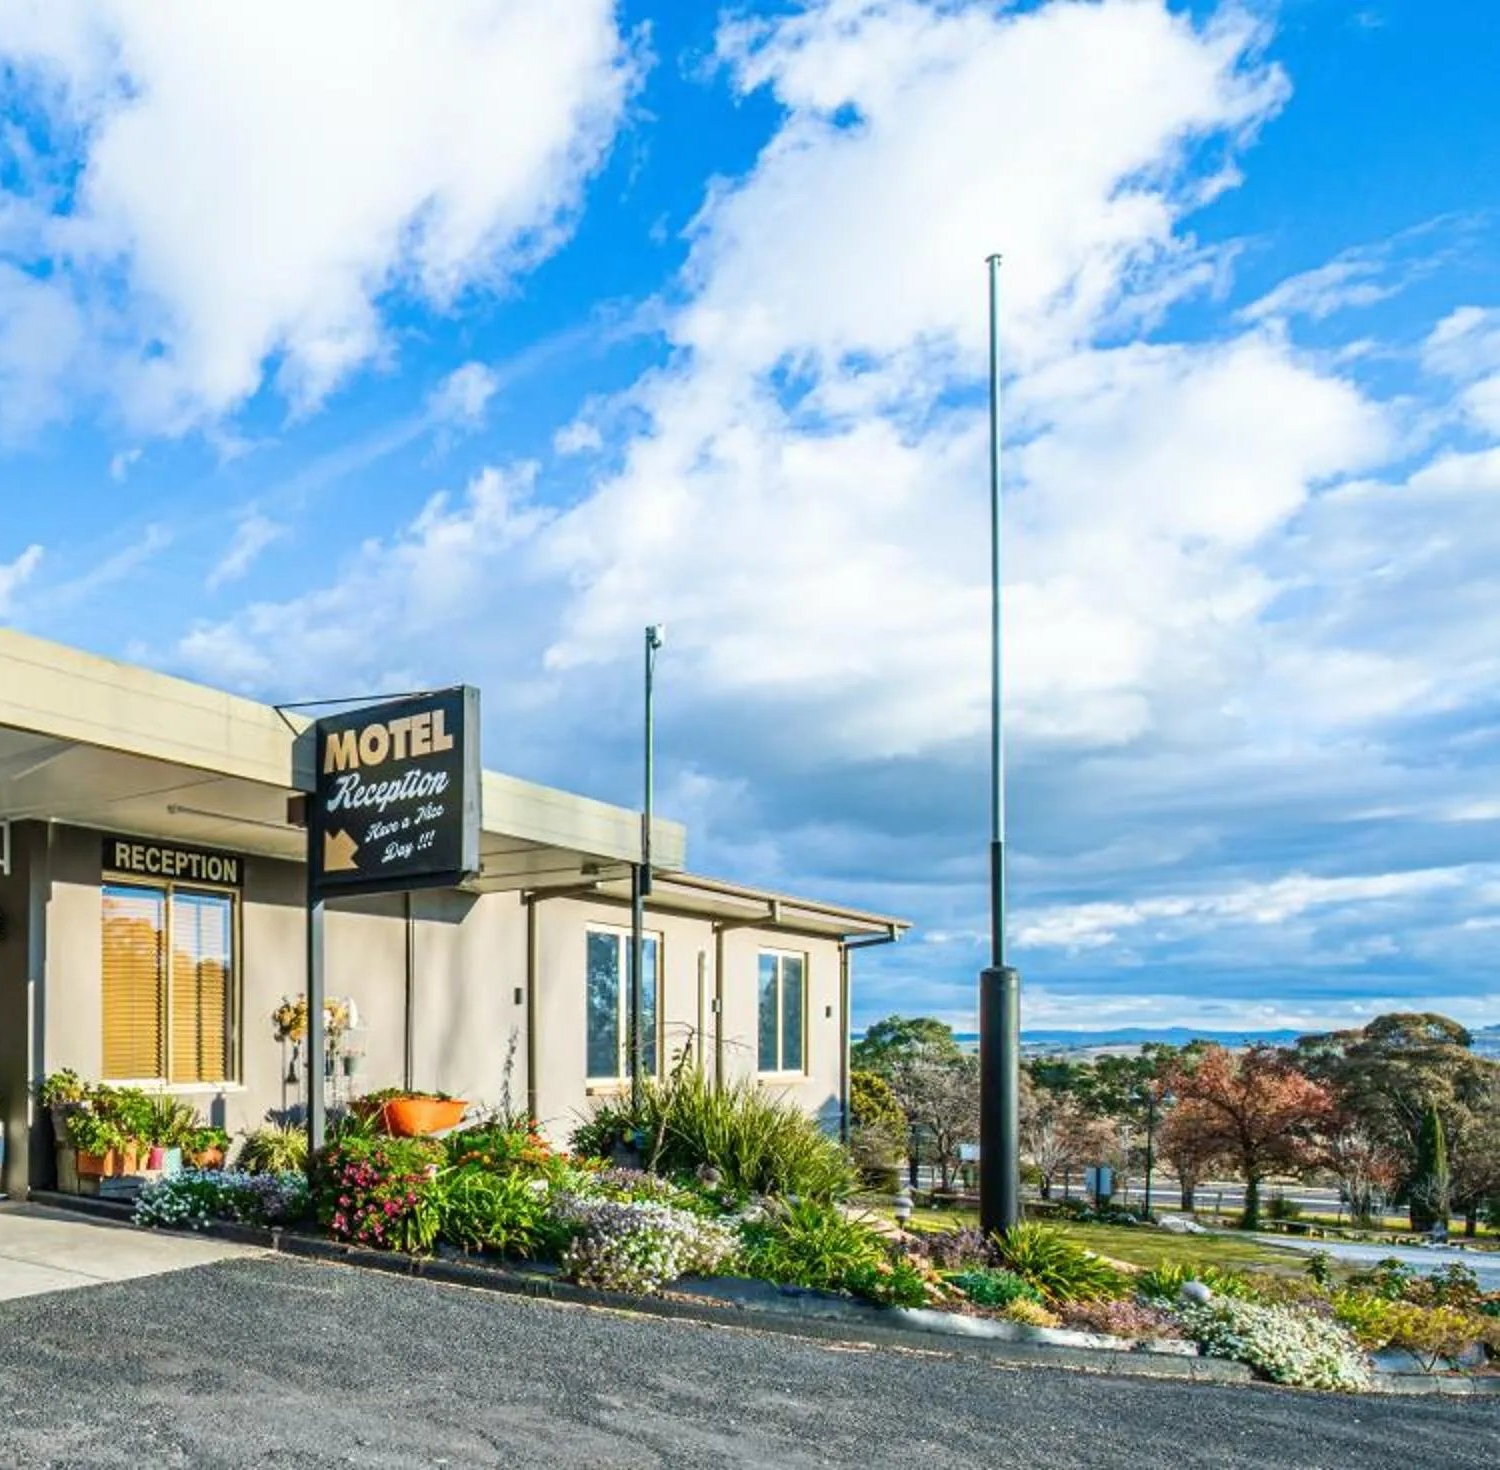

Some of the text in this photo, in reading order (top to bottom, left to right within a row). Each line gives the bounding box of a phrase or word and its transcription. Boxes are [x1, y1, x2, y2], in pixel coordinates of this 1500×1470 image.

[324, 709, 454, 774] MOTEL
[327, 768, 449, 813] Reception
[365, 802, 445, 844] Have a Nice
[115, 842, 237, 883] RECEPTION
[381, 842, 414, 864] Day
